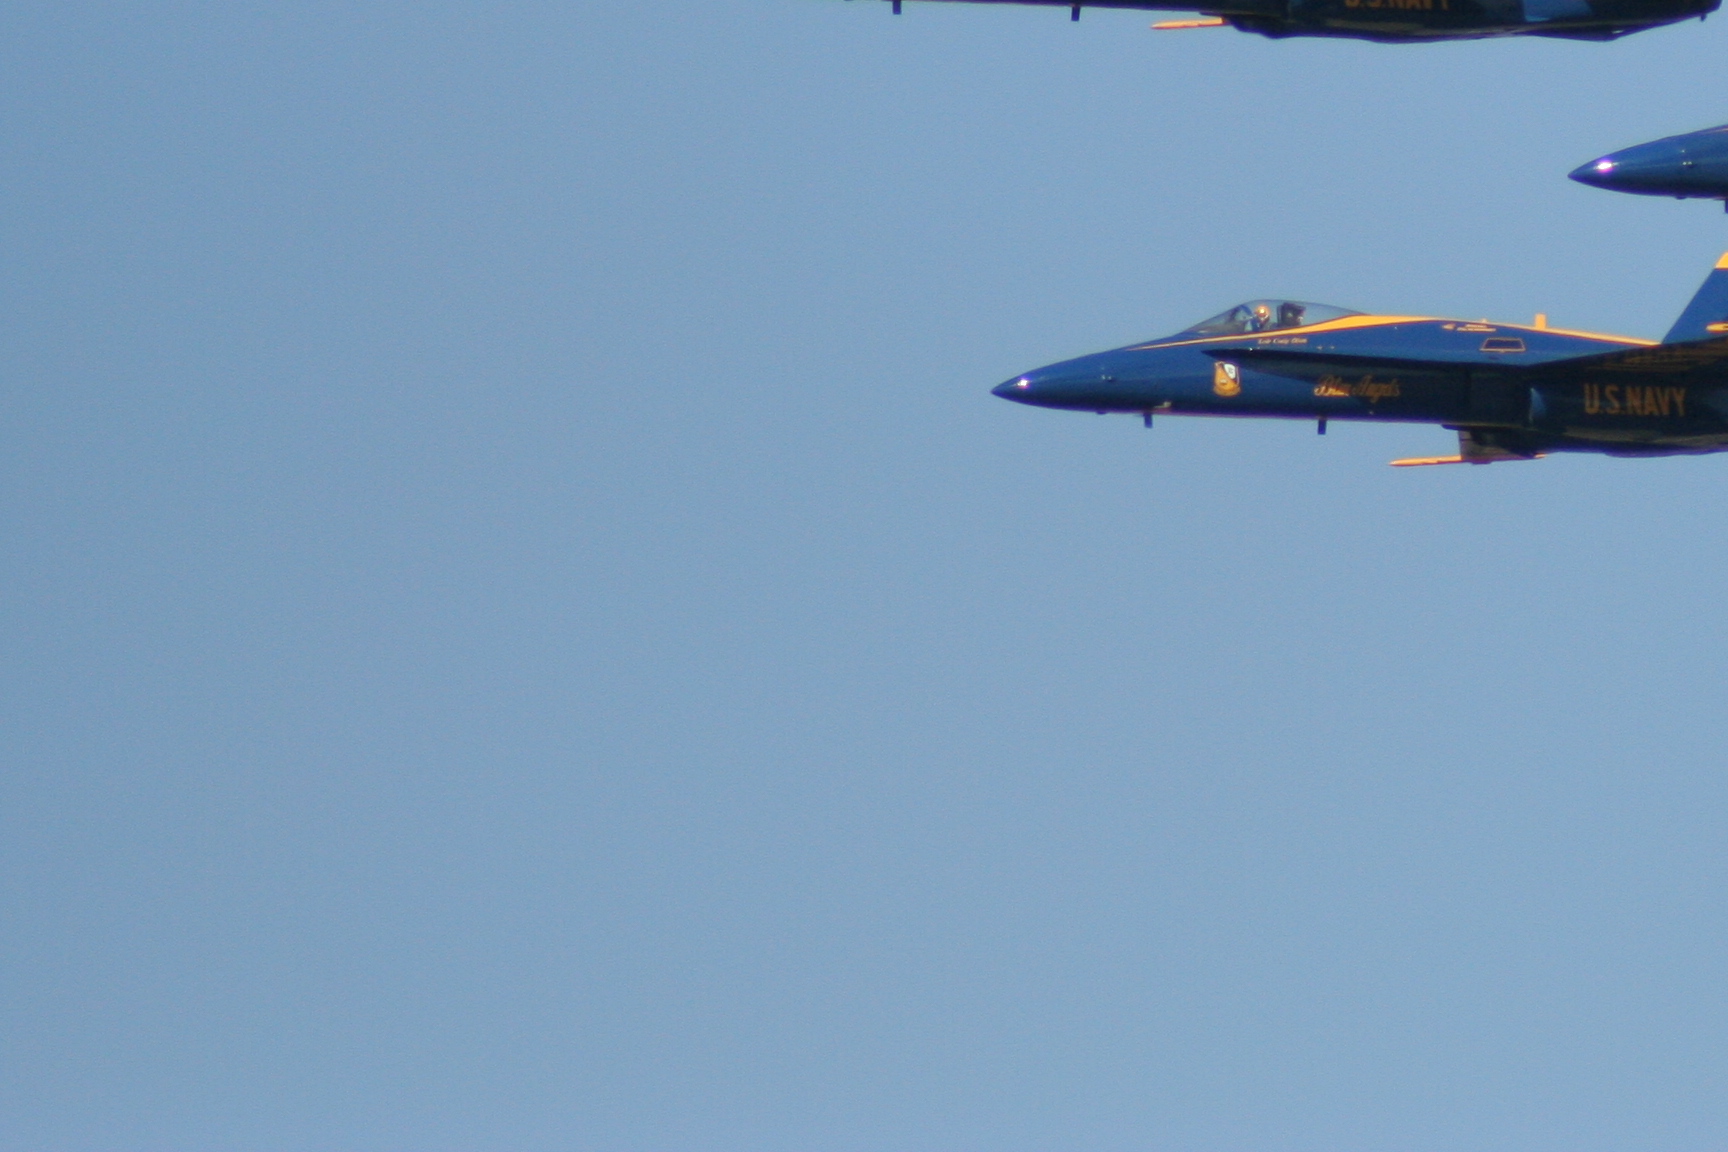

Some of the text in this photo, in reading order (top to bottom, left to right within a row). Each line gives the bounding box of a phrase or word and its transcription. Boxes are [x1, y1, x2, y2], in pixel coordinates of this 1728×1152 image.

[1314, 374, 1400, 403] Blue Angels
[1626, 385, 1686, 417] NAVY
